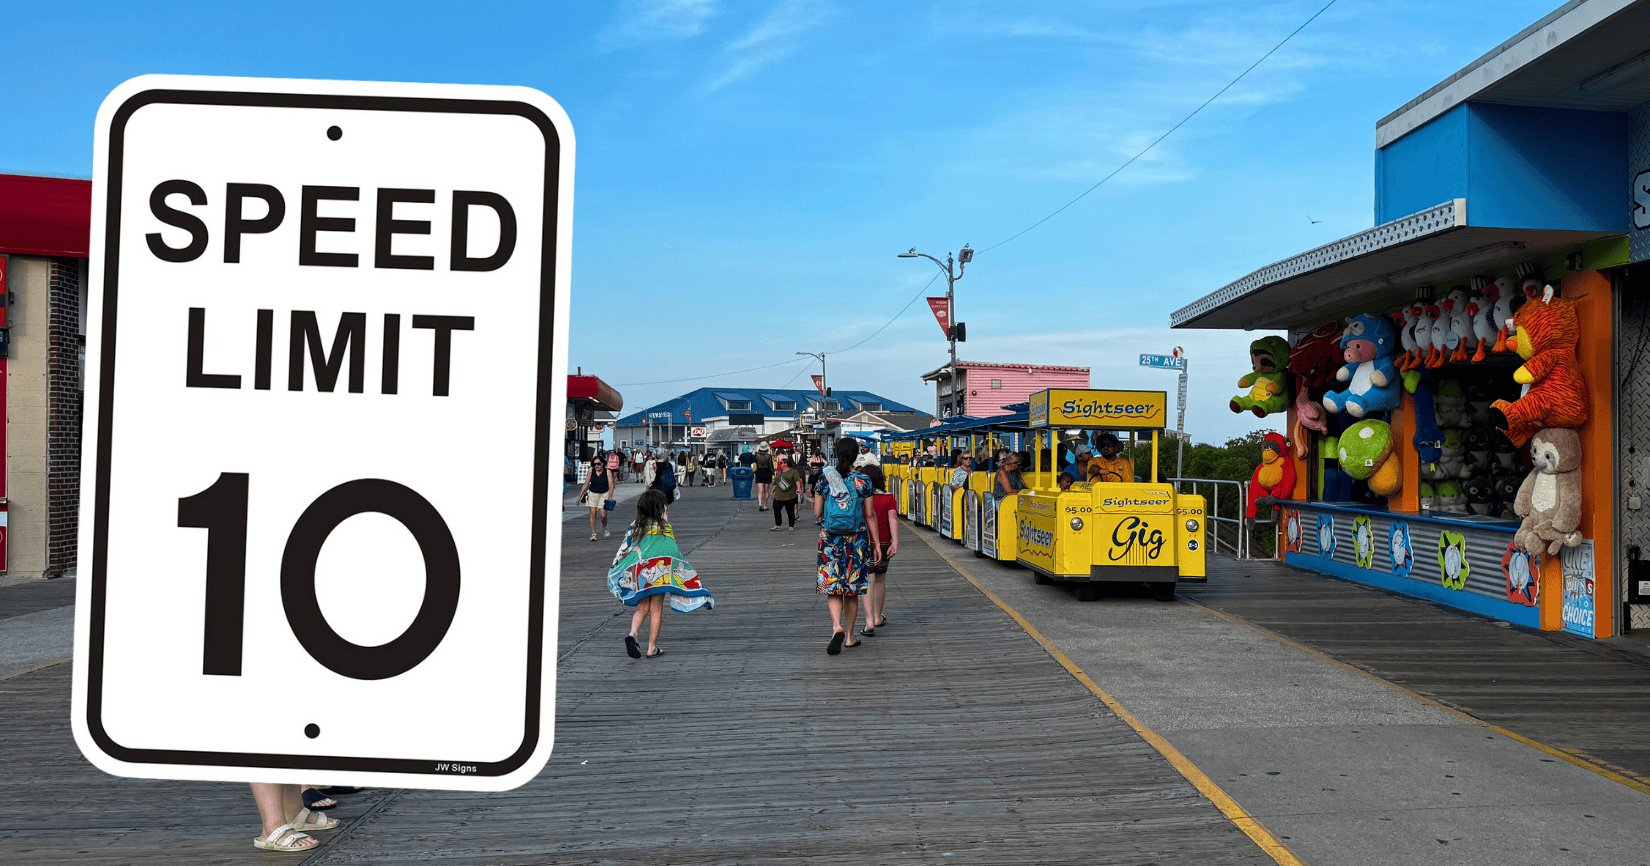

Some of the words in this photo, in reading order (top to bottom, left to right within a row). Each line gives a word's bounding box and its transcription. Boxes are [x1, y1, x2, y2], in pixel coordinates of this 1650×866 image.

[1141, 355, 1159, 365] 25TH
[1163, 357, 1181, 367] AVE
[1062, 398, 1154, 418] Sightseer
[1065, 506, 1092, 514] $5.00
[1103, 497, 1170, 507] Sightseer
[1108, 516, 1167, 561] Gig
[1562, 604, 1593, 627] CHOICE
